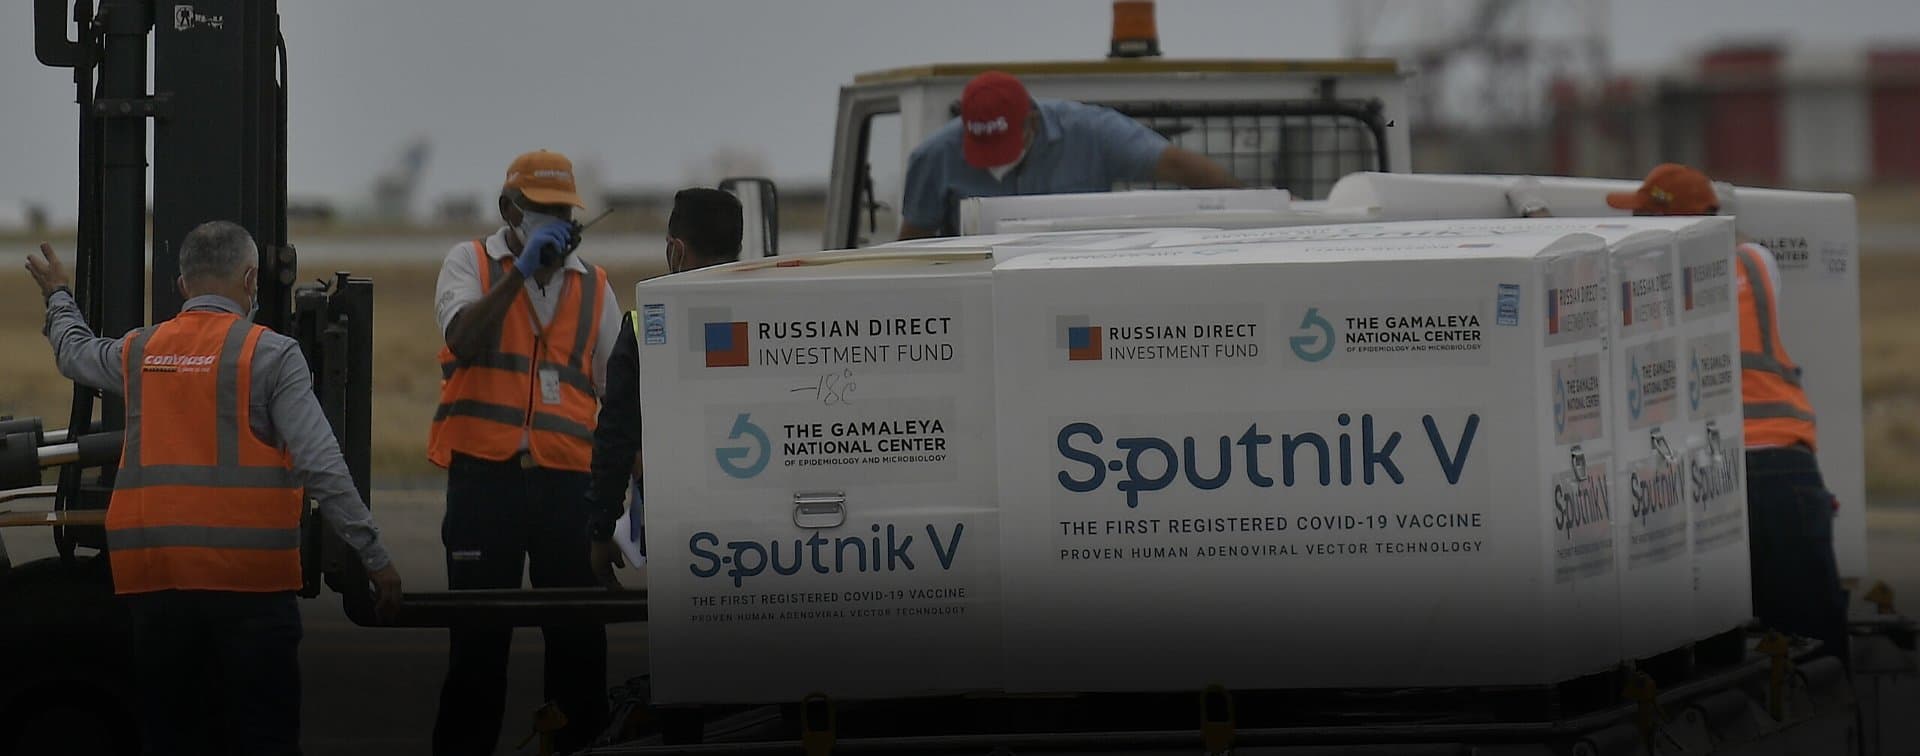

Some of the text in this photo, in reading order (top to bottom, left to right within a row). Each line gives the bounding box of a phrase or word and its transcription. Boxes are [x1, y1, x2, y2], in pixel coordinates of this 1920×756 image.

[758, 317, 952, 340] RUSSIAN DIRECT
[1109, 323, 1257, 341] RUSSIAN DIRECT
[1345, 314, 1481, 330] THE GAMALEYA
[1345, 329, 1481, 344] NATIONAL CENTER
[759, 343, 954, 366] INVESTMENT FUND
[1109, 343, 1259, 361] INVESTMENT FUND
[1410, 344, 1427, 352] AND
[783, 419, 945, 439] THE GAMALEYA
[783, 437, 946, 456] NATIONAL CENTER
[784, 454, 947, 467] OF EPIDEMIOLOGY AND MICROBIOLOGY
[1056, 412, 1481, 509] Sputnik V
[1059, 512, 1482, 536] THE FIRST REGISTERED COVID-19 VACCINE
[688, 519, 965, 588] Sputnik V
[1060, 540, 1482, 561] PROVEN HUMAN ADENOVIRAL VECTOR TECHNOLOGY
[690, 587, 966, 607] THE FIRST REGISTERED COVID-19 VACCINE
